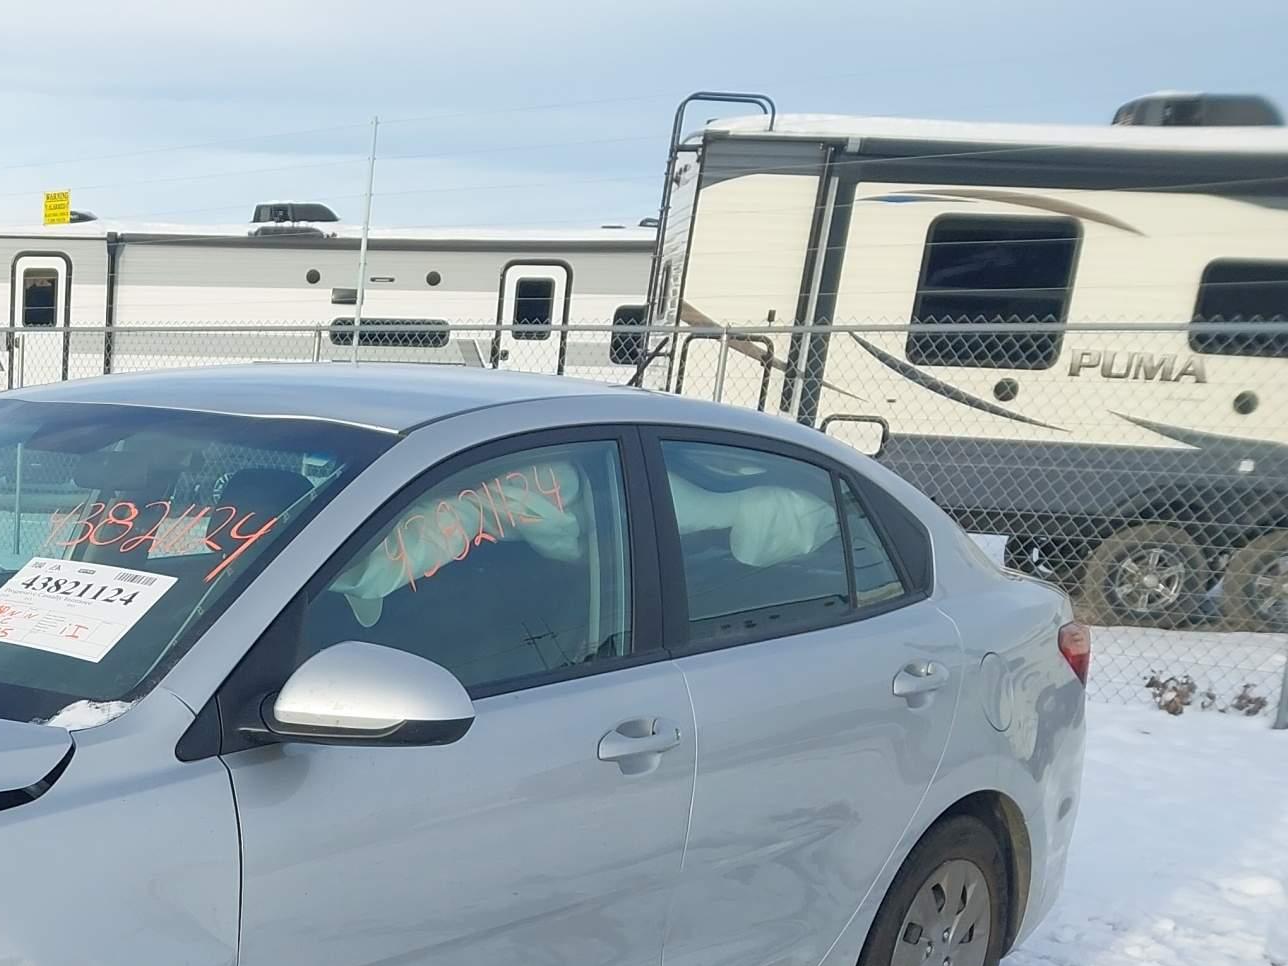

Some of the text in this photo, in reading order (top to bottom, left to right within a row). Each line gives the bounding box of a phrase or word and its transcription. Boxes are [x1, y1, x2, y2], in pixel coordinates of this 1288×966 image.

[1068, 349, 1207, 383] PUMA
[383, 465, 564, 594] 43821124
[21, 574, 140, 605] 43821124
